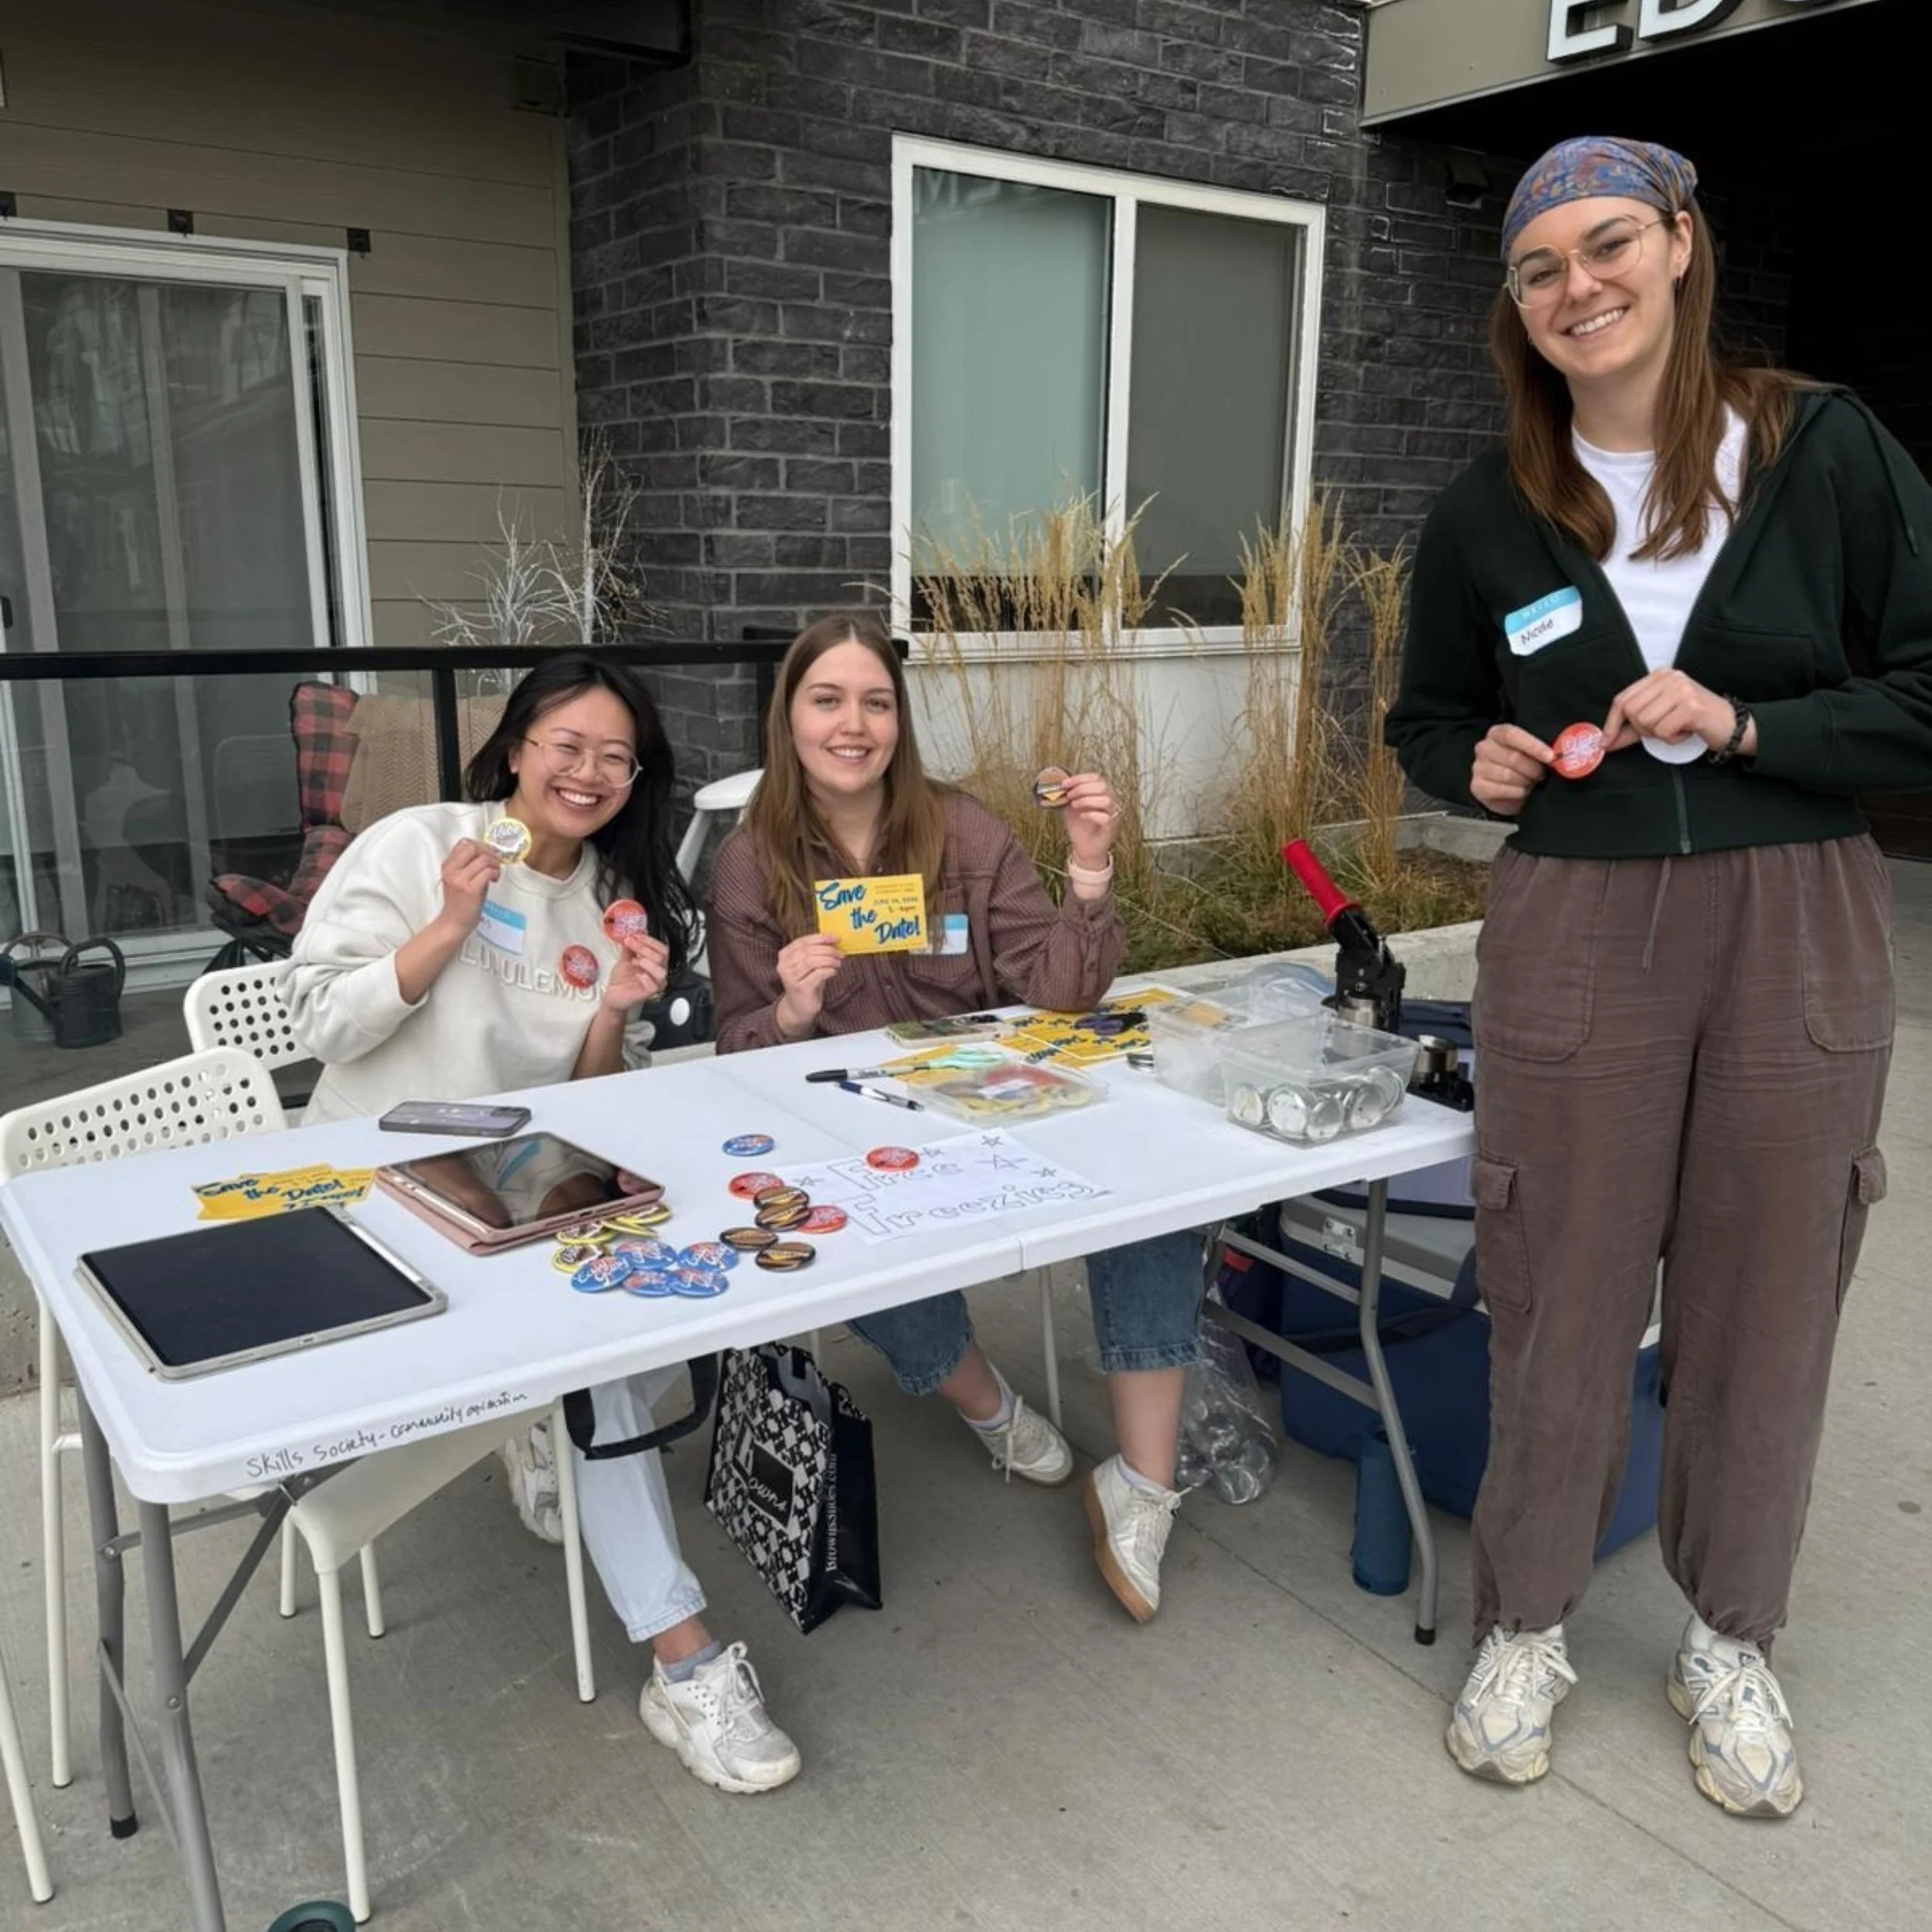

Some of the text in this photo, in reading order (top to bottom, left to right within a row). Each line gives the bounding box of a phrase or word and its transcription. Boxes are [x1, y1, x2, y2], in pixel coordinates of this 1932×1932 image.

[815, 882, 867, 910] Save
[850, 906, 878, 930] the
[873, 914, 920, 944] Date!
[192, 1179, 259, 1197] Save
[243, 1185, 280, 1199] the
[280, 1178, 345, 1199] Date!
[246, 1449, 304, 1478] Skills
[312, 1430, 377, 1462] Society
